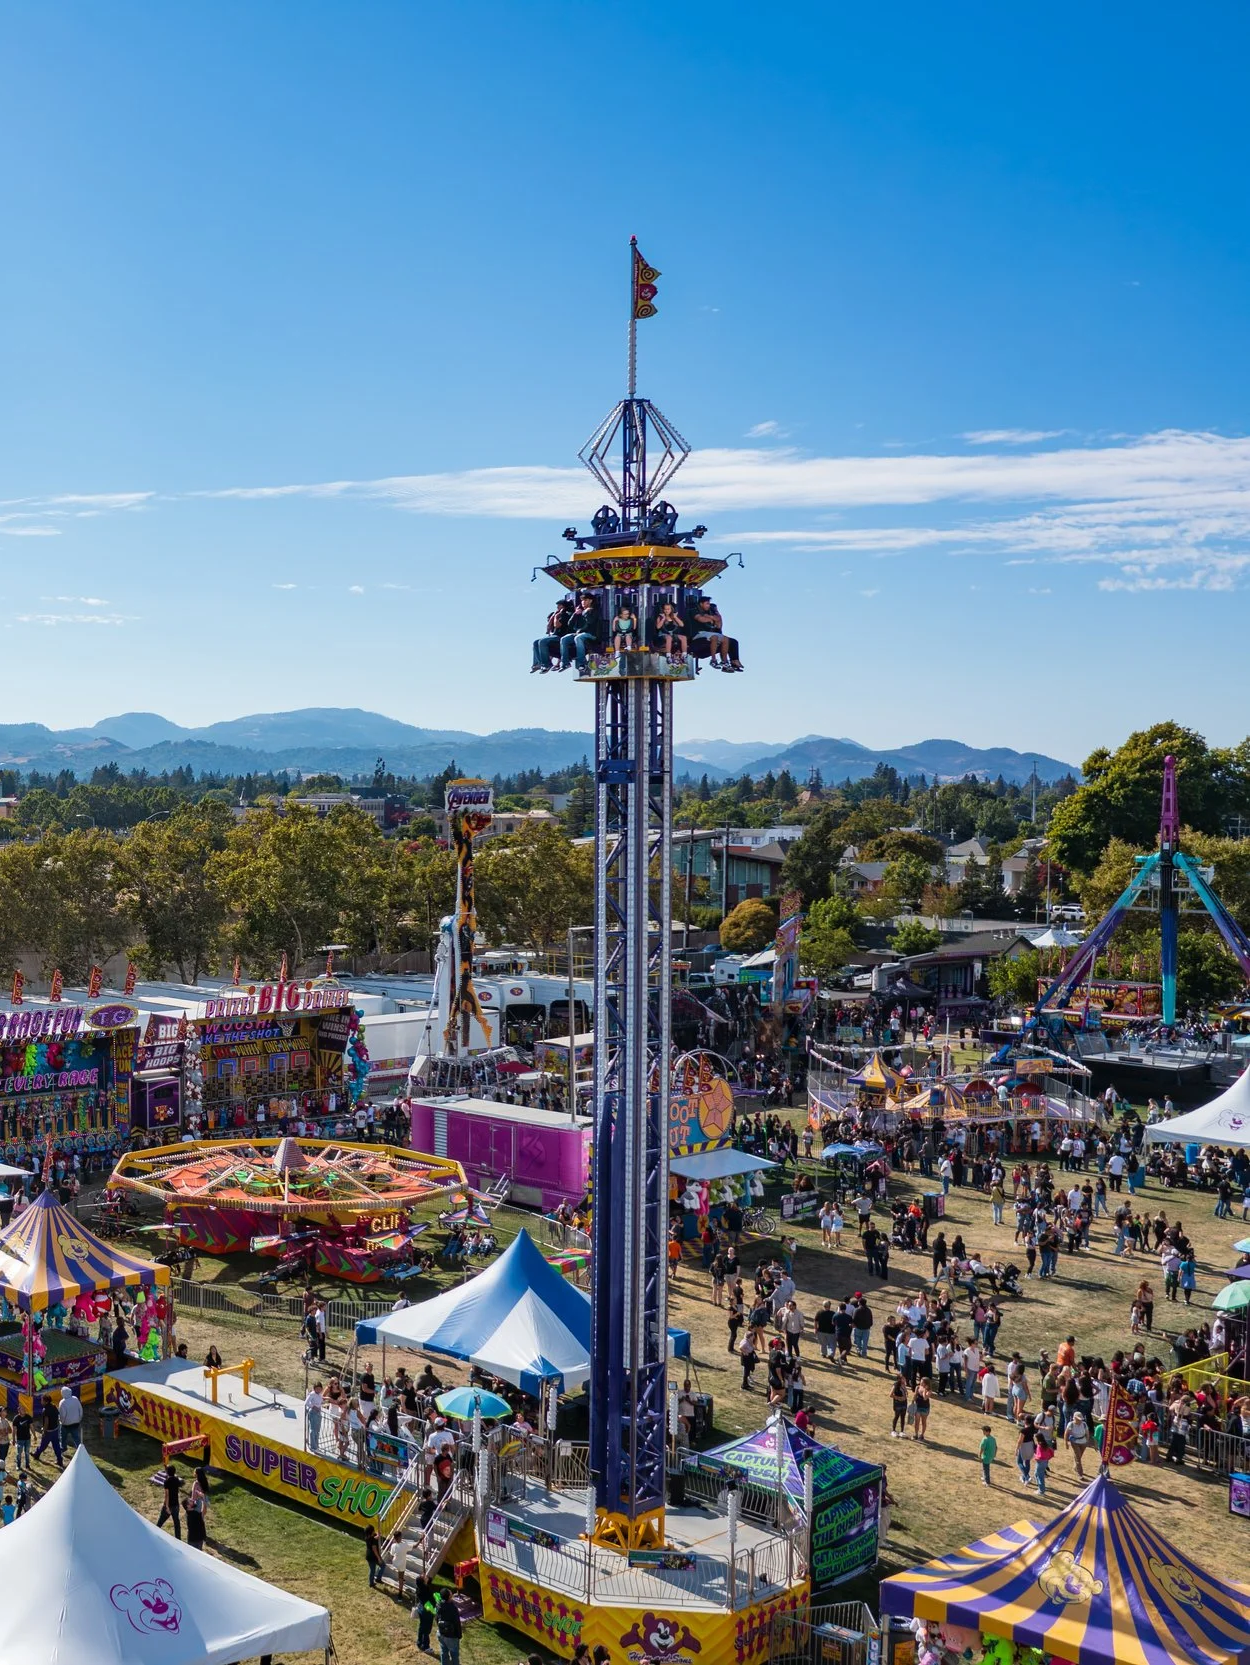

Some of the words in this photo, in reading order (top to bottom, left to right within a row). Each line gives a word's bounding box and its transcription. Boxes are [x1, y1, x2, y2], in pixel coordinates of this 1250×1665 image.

[205, 996, 256, 1018] PRIZES
[258, 982, 301, 1013] BIG
[303, 989, 350, 1010] PRIZES
[6, 1009, 54, 1039] RACE
[52, 1006, 83, 1034] FUN
[158, 1023, 178, 1039] BIG
[225, 1031, 246, 1043] THE
[249, 1028, 280, 1040] SHOT
[154, 1044, 178, 1057] BIG
[145, 1054, 181, 1069] HOOPS
[5, 1073, 54, 1093] EVERY
[58, 1068, 99, 1088] RACE
[724, 1452, 788, 1469] CAPTURE
[226, 1433, 320, 1495] SUPER
[318, 1476, 392, 1518] SHOT
[817, 1498, 857, 1529] CAPTURE
[814, 1530, 834, 1548] THE
[835, 1509, 861, 1538] RUSH!
[814, 1550, 830, 1566] GET
[817, 1561, 841, 1577] REPLAY
[491, 1586, 542, 1618] SUPER
[543, 1611, 582, 1636] SHOT
[671, 1653, 693, 1664] Sons
